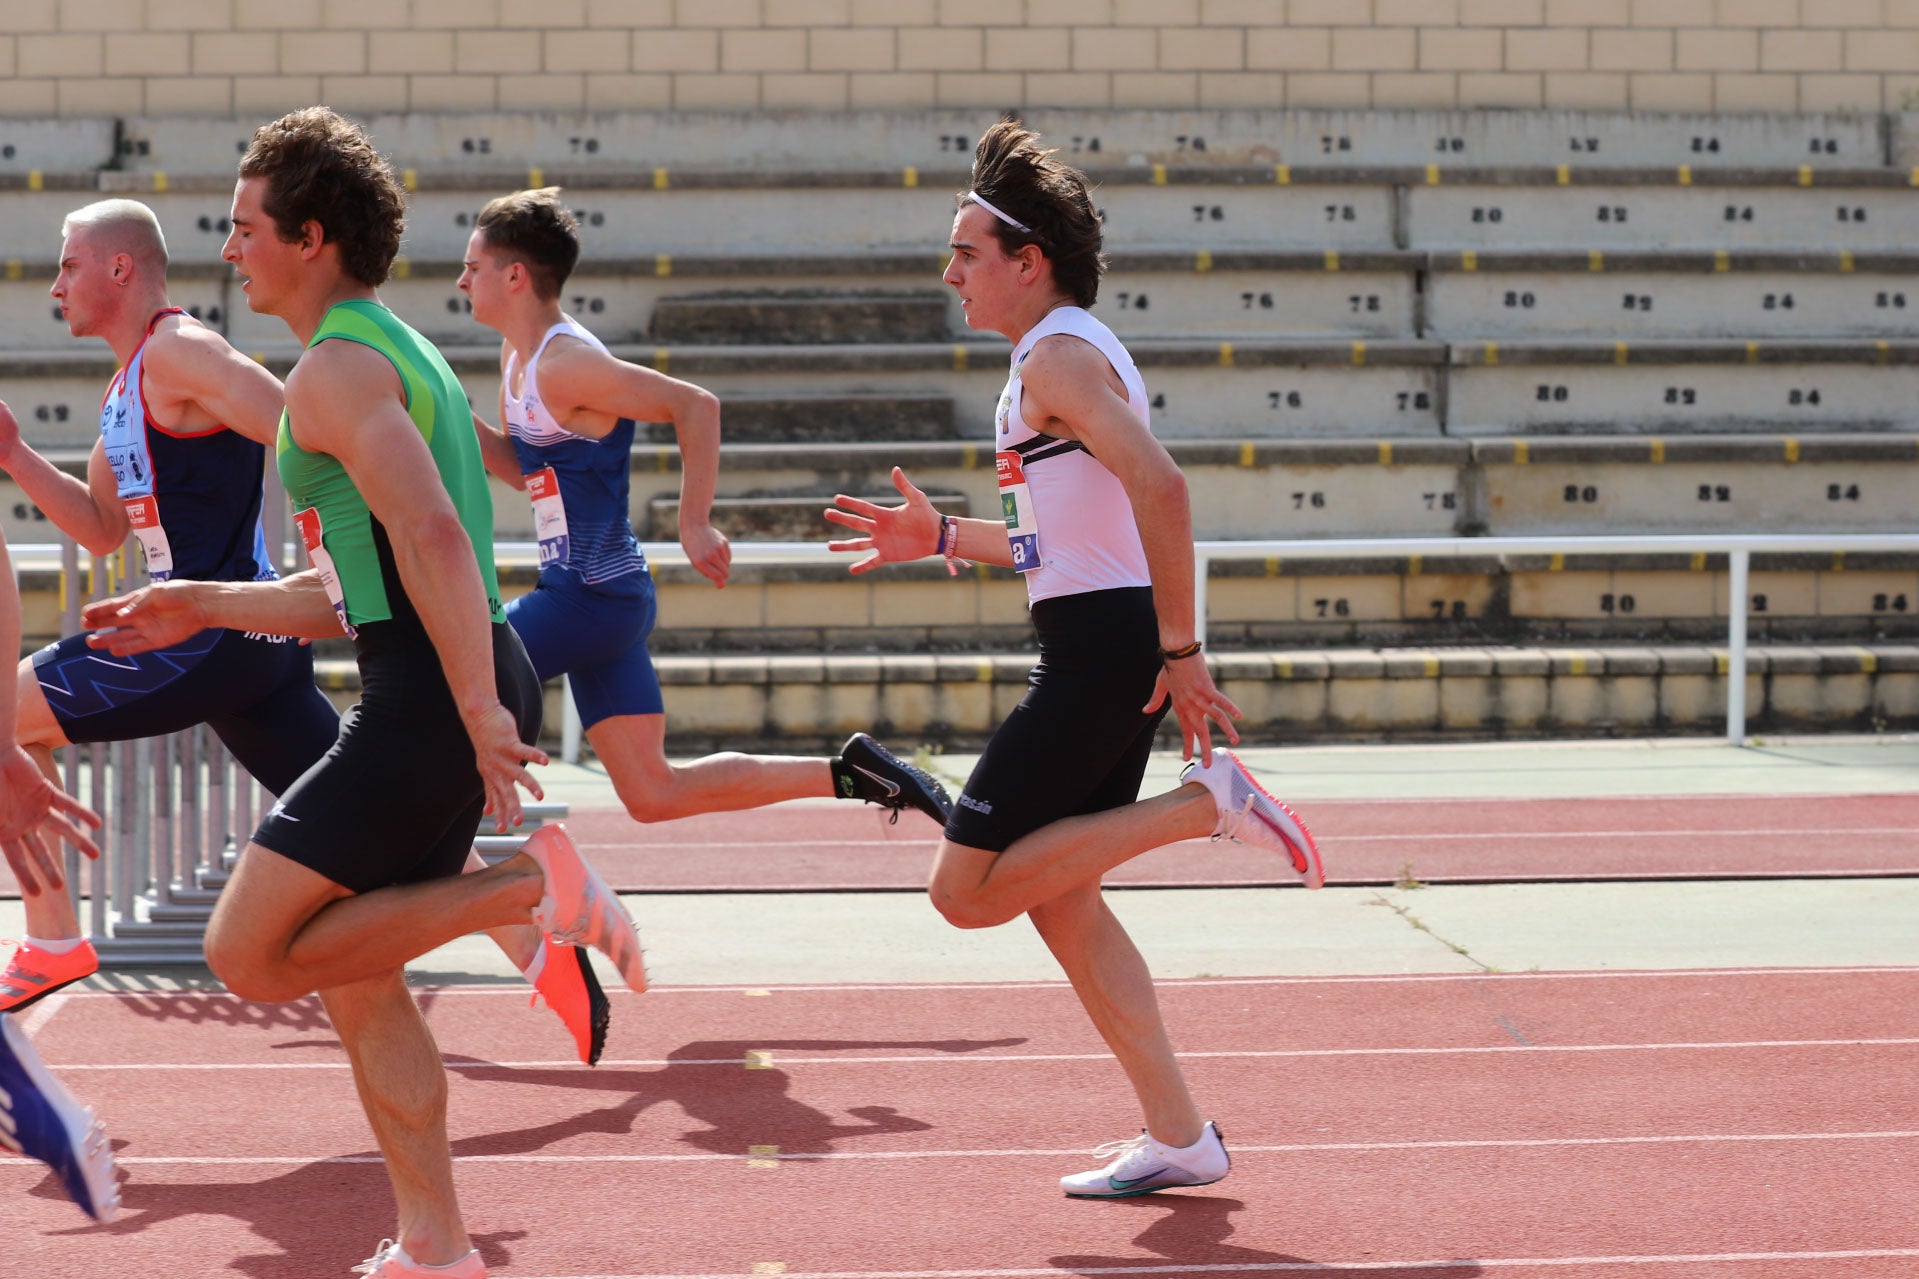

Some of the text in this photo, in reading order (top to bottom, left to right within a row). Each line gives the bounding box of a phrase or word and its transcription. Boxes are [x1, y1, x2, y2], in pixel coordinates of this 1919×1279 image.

[570, 138, 599, 154] 70
[939, 135, 969, 152] 72
[1073, 137, 1100, 153] 74
[1176, 136, 1206, 153] 76
[1322, 136, 1351, 153] 78
[1691, 138, 1720, 153] 84
[1810, 139, 1837, 154] 86
[575, 211, 605, 226] 70
[1193, 206, 1223, 221] 76
[1326, 205, 1355, 221] 78
[1472, 208, 1502, 223] 80
[1597, 206, 1626, 222] 82
[1724, 206, 1753, 221] 84
[1838, 207, 1866, 222] 86
[573, 297, 605, 314] 70
[1118, 293, 1148, 310] 74
[1242, 293, 1273, 308] 76
[1350, 296, 1379, 312] 78
[1504, 291, 1535, 308] 80
[1623, 294, 1652, 311] 82
[1763, 294, 1794, 310] 84
[1876, 292, 1906, 308] 86
[1268, 392, 1301, 408] 76
[1395, 391, 1430, 411] 78
[1536, 385, 1568, 401] 80
[1665, 387, 1695, 405] 82
[1789, 390, 1820, 405] 84
[1292, 492, 1325, 509] 76
[1564, 485, 1597, 503] 80
[1698, 485, 1730, 502] 82
[1827, 484, 1860, 501] 84
[1422, 492, 1456, 511] 78
[1314, 598, 1349, 618] 76
[1601, 594, 1635, 612] 80
[1873, 593, 1907, 611] 84
